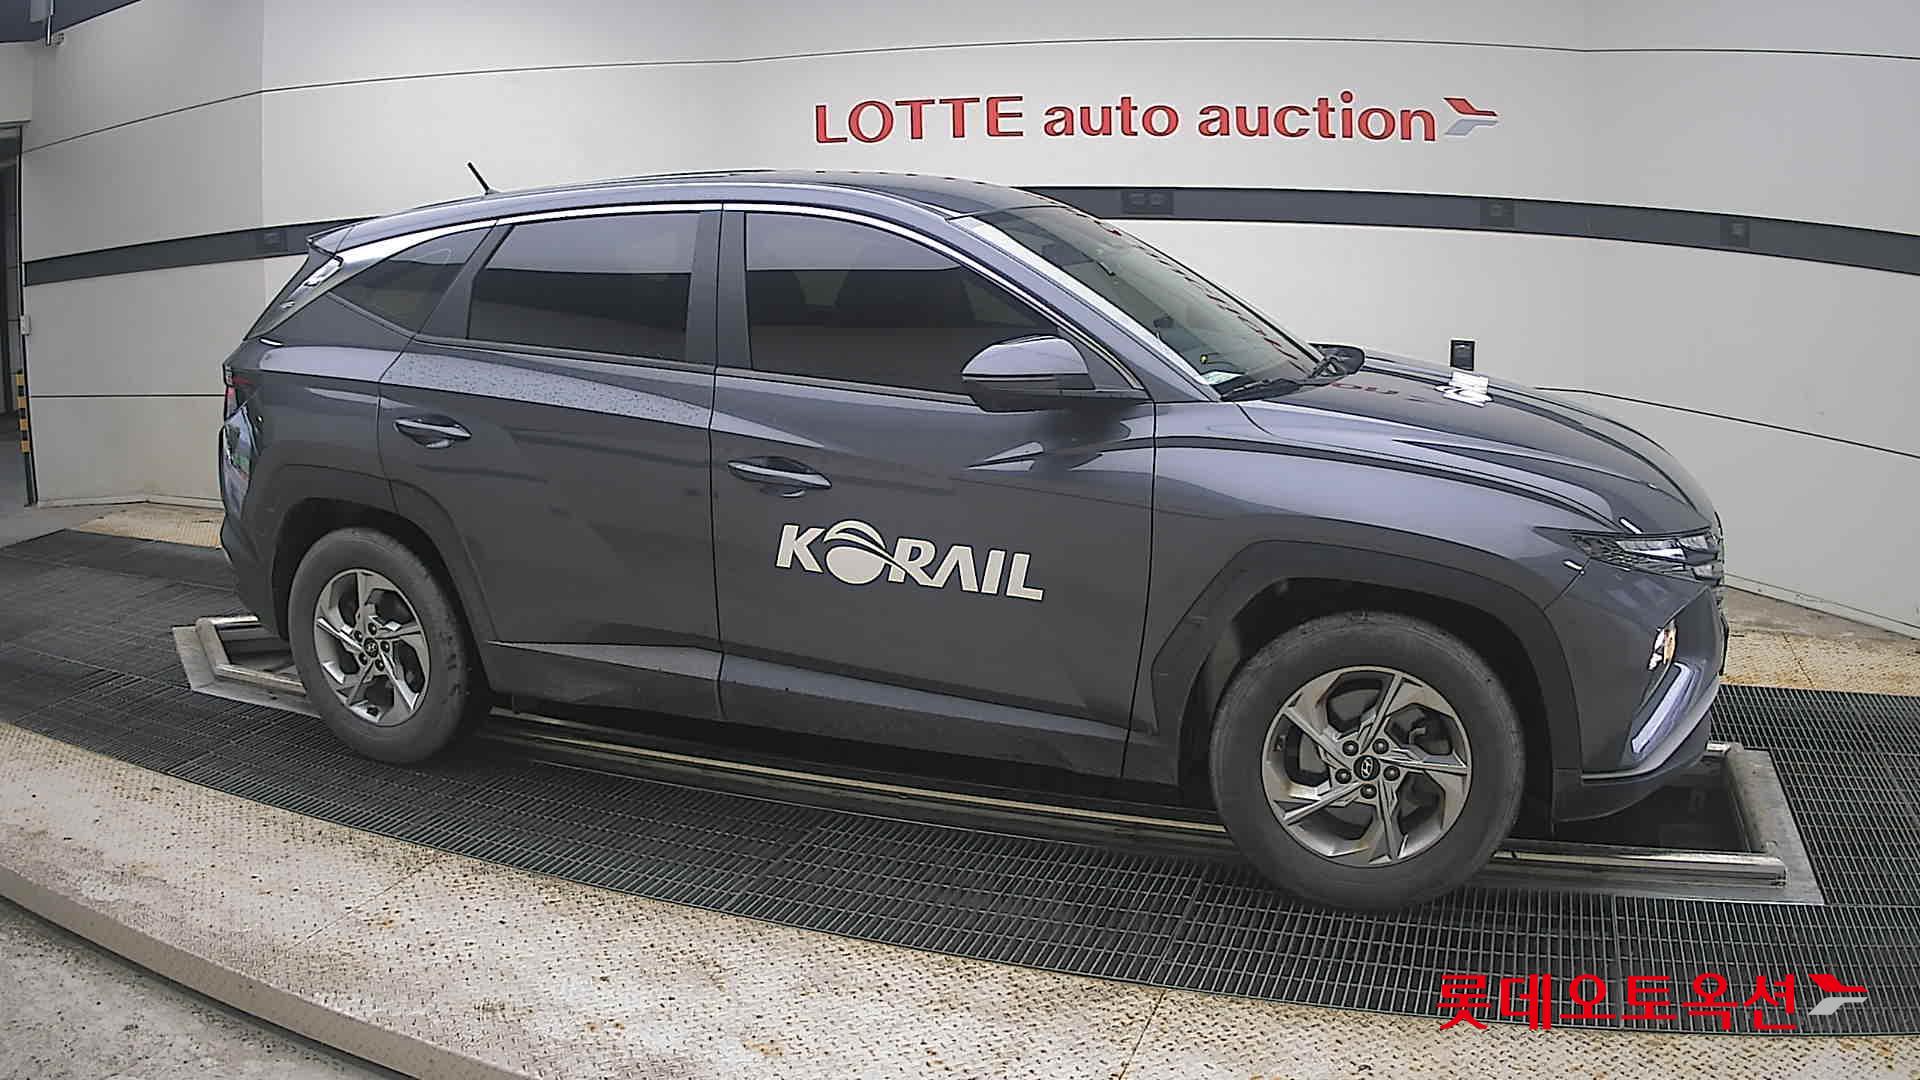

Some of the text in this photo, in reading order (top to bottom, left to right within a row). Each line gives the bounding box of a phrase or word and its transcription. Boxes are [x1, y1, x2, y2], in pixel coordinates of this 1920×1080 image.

[815, 91, 1437, 144] LOTTE auto auction
[776, 520, 1044, 601] KORAIL
